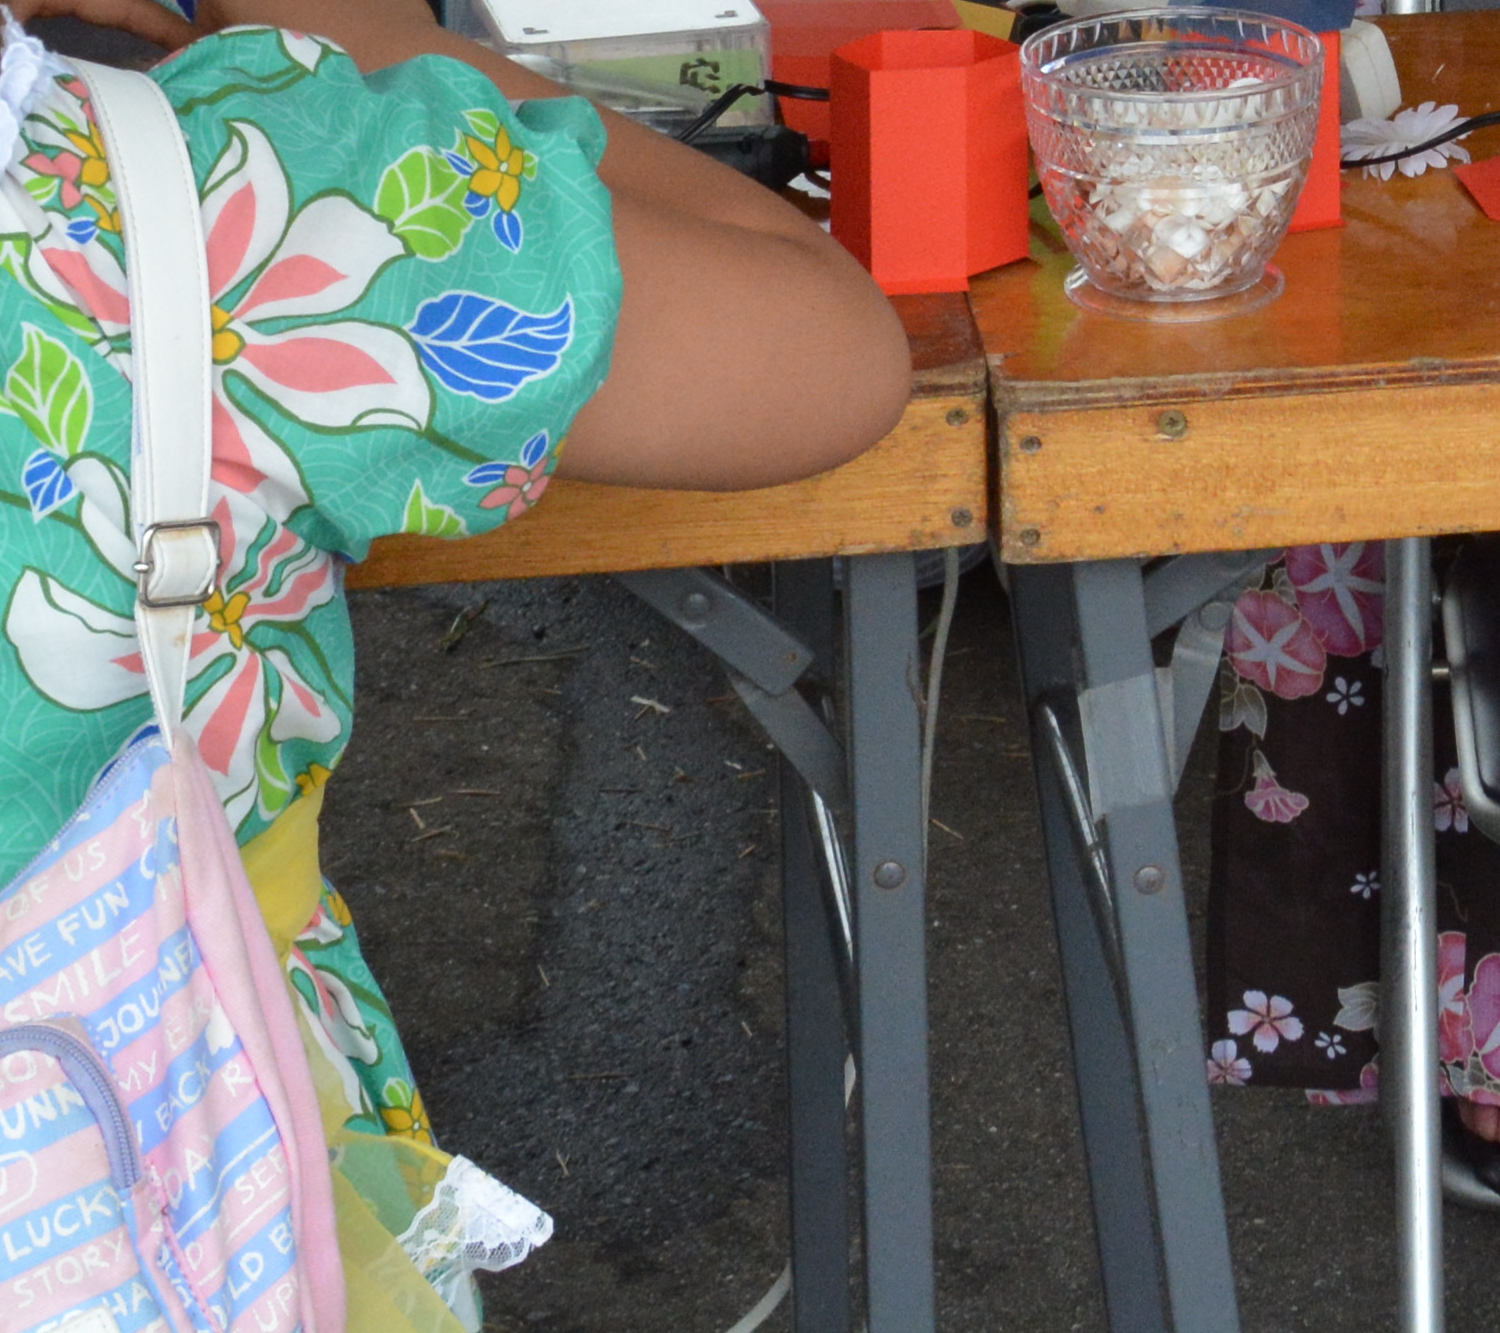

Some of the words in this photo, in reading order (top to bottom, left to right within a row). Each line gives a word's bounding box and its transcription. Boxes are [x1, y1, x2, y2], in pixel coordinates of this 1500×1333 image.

[6, 875, 49, 921] OF
[63, 840, 107, 882] US
[56, 881, 130, 946] FUN
[3, 919, 147, 1024] SMILE
[13, 1231, 125, 1308] STORY
